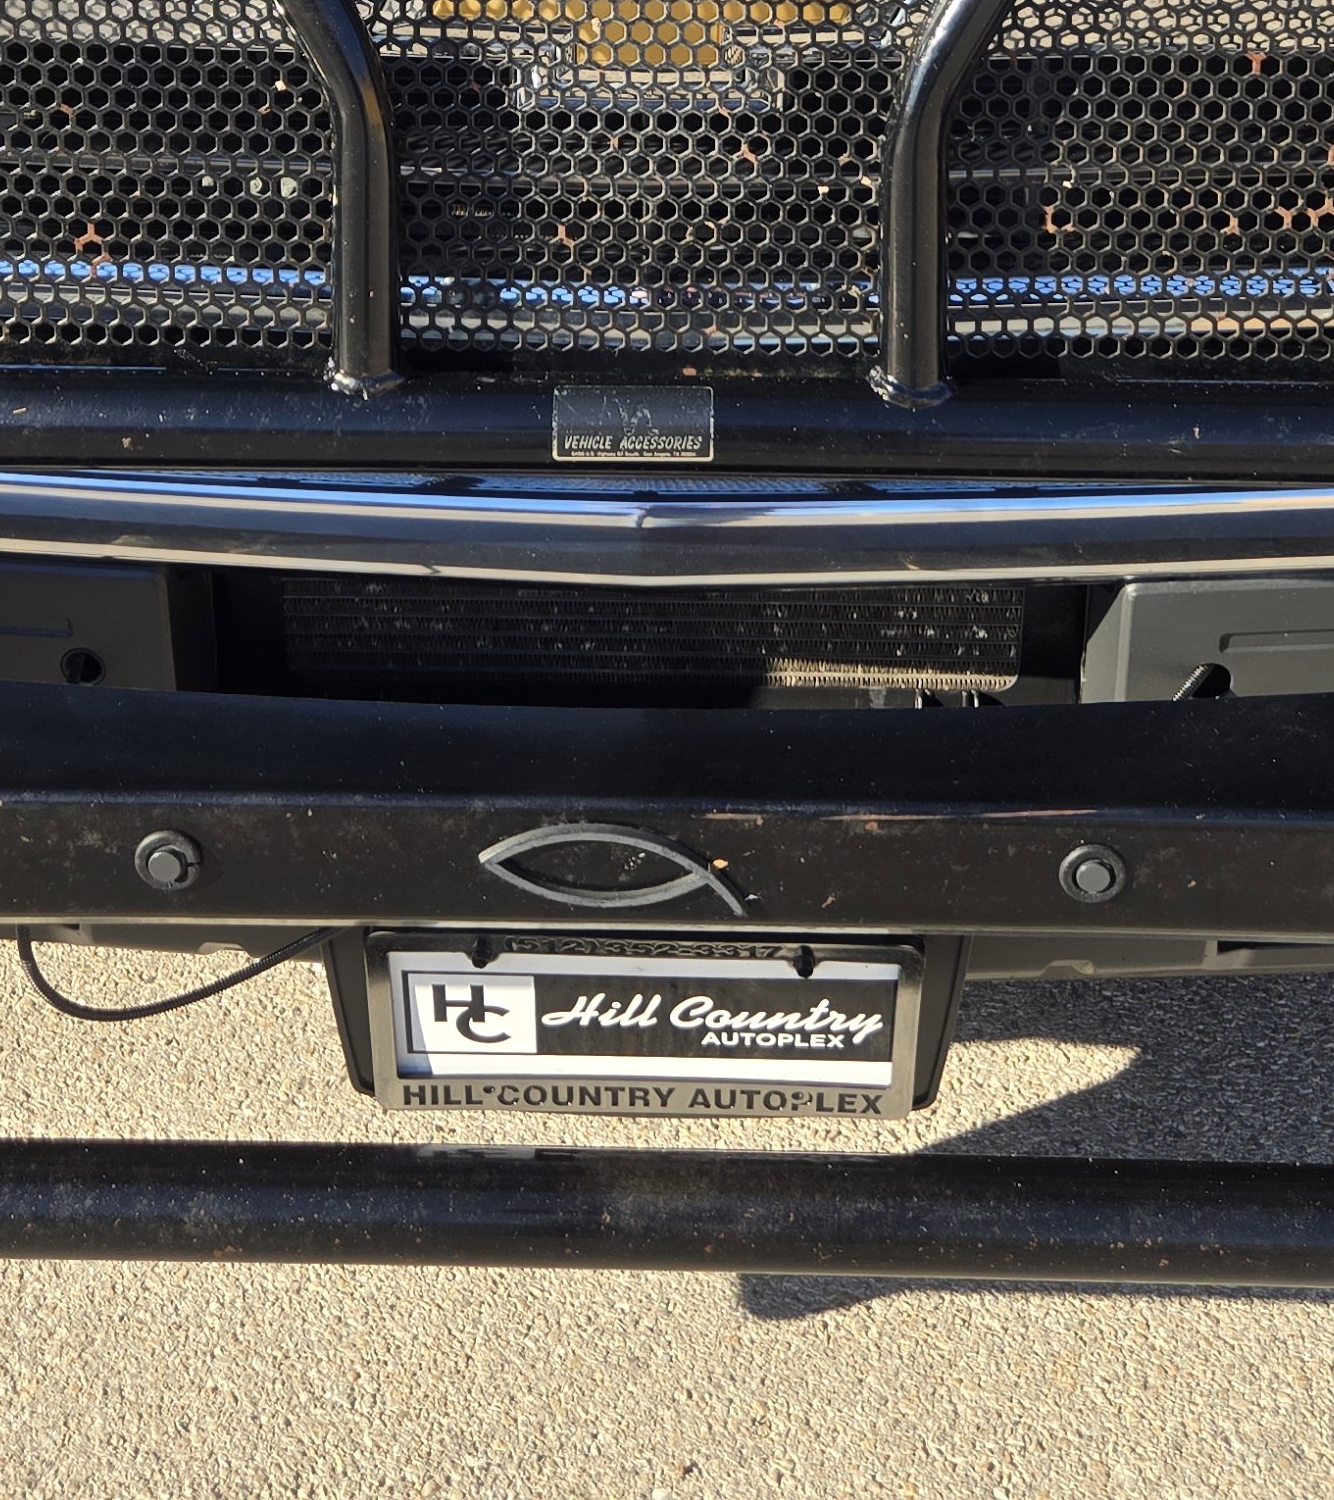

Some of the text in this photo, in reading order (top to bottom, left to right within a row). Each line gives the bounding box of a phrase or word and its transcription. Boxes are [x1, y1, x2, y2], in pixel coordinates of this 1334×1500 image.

[564, 435, 704, 451] VEHICLE ACCESSORIES
[431, 983, 512, 1044] HC
[540, 991, 885, 1046] Hill Country
[700, 1031, 846, 1049] AUTOPLEX
[402, 1083, 884, 1116] HILL COUNTRY AUTOPLEX
